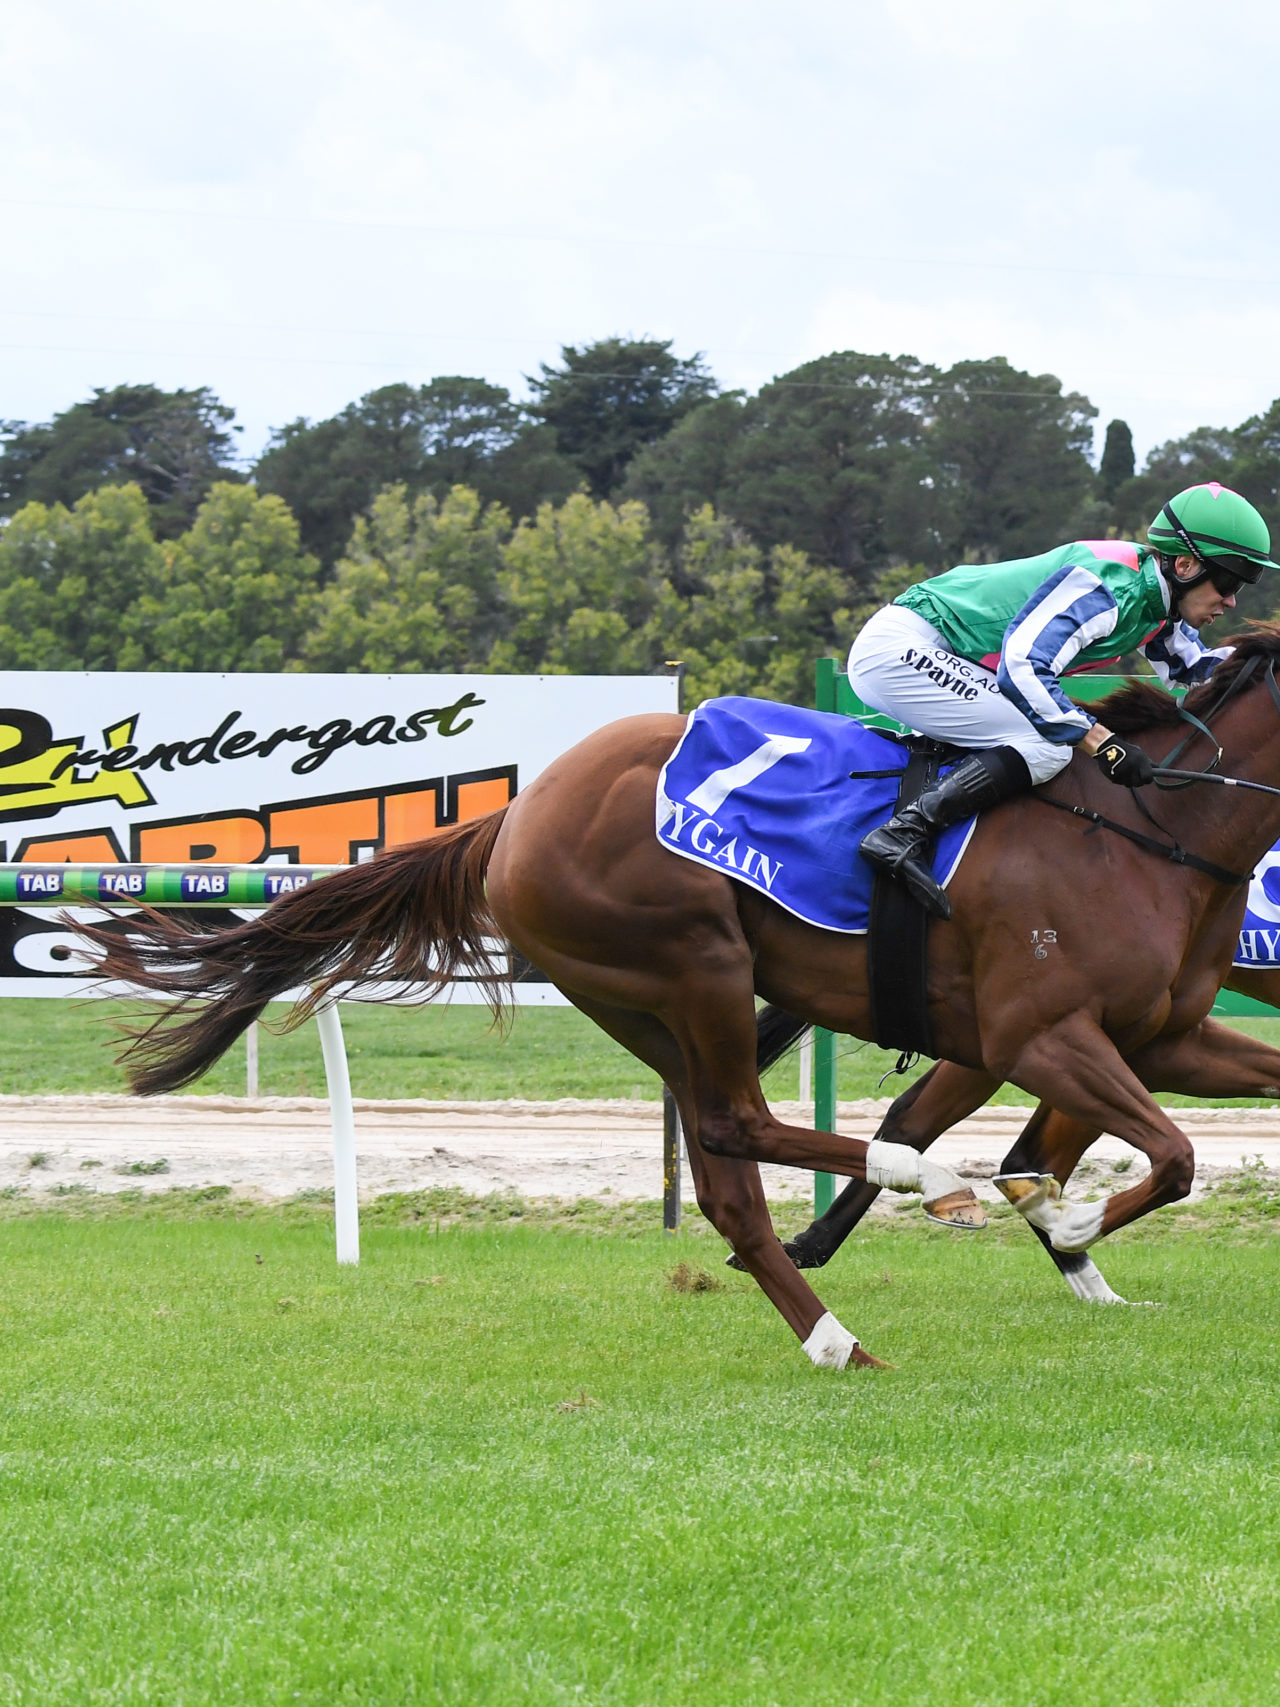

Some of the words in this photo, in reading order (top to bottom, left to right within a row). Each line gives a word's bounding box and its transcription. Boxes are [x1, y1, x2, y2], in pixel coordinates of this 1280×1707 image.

[900, 648, 979, 701] S.Payne
[684, 732, 813, 816] 1
[20, 874, 60, 892] TAB
[102, 874, 143, 892] TAB
[184, 874, 226, 893] TAB
[1030, 929, 1058, 944] 13
[1034, 943, 1048, 960] 6
